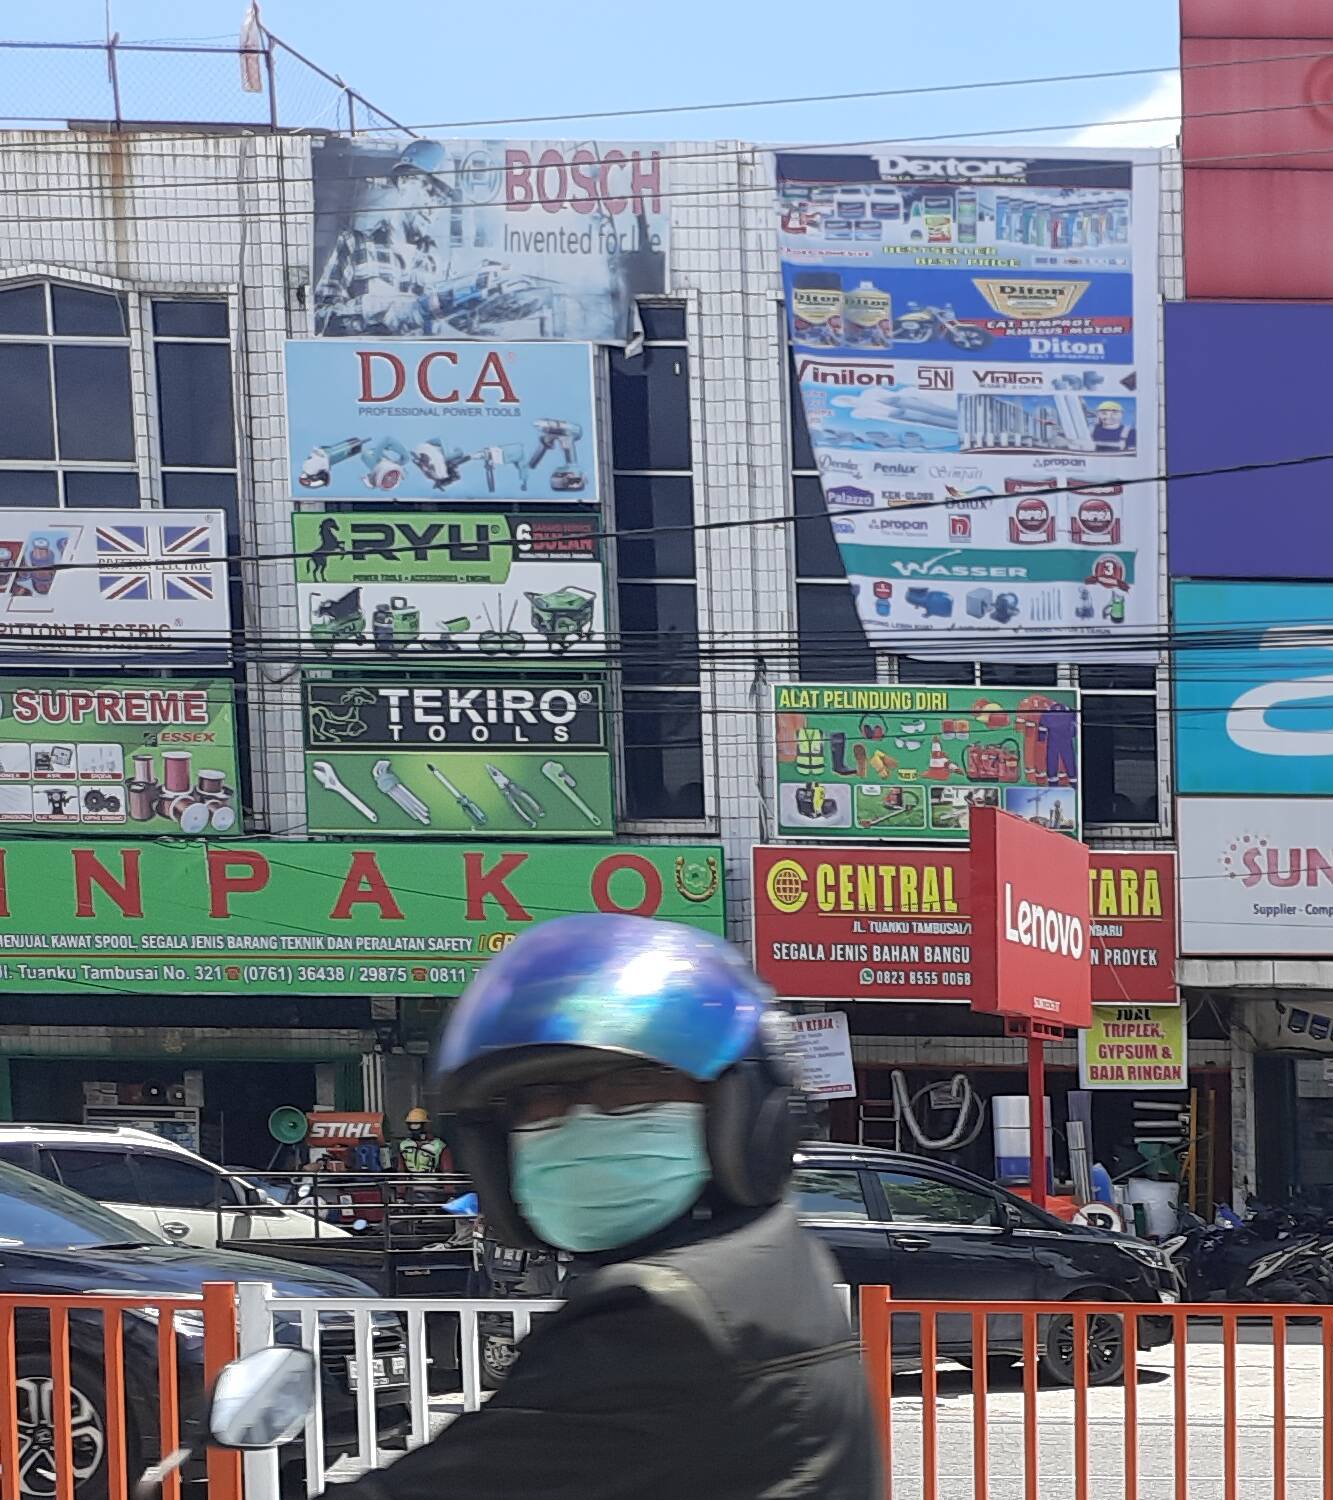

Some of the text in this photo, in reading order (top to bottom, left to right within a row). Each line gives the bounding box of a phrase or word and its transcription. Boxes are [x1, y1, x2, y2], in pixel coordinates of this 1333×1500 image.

[505, 149, 661, 214] BOSCH
[504, 224, 592, 254] Invented
[1000, 285, 1065, 296] Diton
[1029, 337, 1105, 355] Diton
[356, 351, 520, 403] DCA
[358, 407, 521, 417] PROFESSIONAL POWER TOOLS
[1043, 458, 1086, 468] propan
[881, 520, 928, 531] propan
[350, 523, 491, 562] RYU
[891, 550, 1028, 578] WASSER
[1104, 561, 1115, 576] 3
[13, 689, 208, 724] SUPREME
[379, 689, 577, 724] TEKIRO
[780, 689, 948, 711] ALAT PELINDUNG DIRI
[161, 731, 216, 743] ESSEX
[388, 725, 571, 742] TOOLS
[816, 863, 958, 913] CENTRAL
[1253, 903, 1296, 917] Supplier
[1005, 882, 1083, 960] Lenovo
[51, 936, 92, 949] KAWAT
[142, 936, 188, 949] SEGALA
[191, 936, 225, 949] JENIS
[227, 936, 278, 950] BARANG
[280, 936, 325, 950] TEKNIK
[327, 937, 353, 950] DAN
[356, 937, 426, 951] PERALATAN
[428, 938, 473, 951] SAFETY
[773, 943, 826, 960] SEGALA
[830, 943, 868, 961] JENIS
[873, 945, 919, 962] BAHAN
[1104, 949, 1158, 966] PROYEK
[17, 965, 76, 980] Tuanku
[81, 965, 158, 981] Tambusai
[163, 966, 190, 981] No.
[195, 966, 222, 981] 321
[243, 966, 293, 984] (0761)
[298, 967, 345, 982] 36438
[359, 968, 407, 983] 29875
[430, 968, 466, 983] 0811
[876, 971, 905, 984] 0823
[1116, 1008, 1152, 1021] JUAL
[1103, 1022, 1166, 1039] TRIPLEK,
[1098, 1044, 1173, 1060] GYPSUM &
[1089, 1065, 1182, 1081] BAJA RINGAN
[311, 1121, 377, 1139] STIHL
